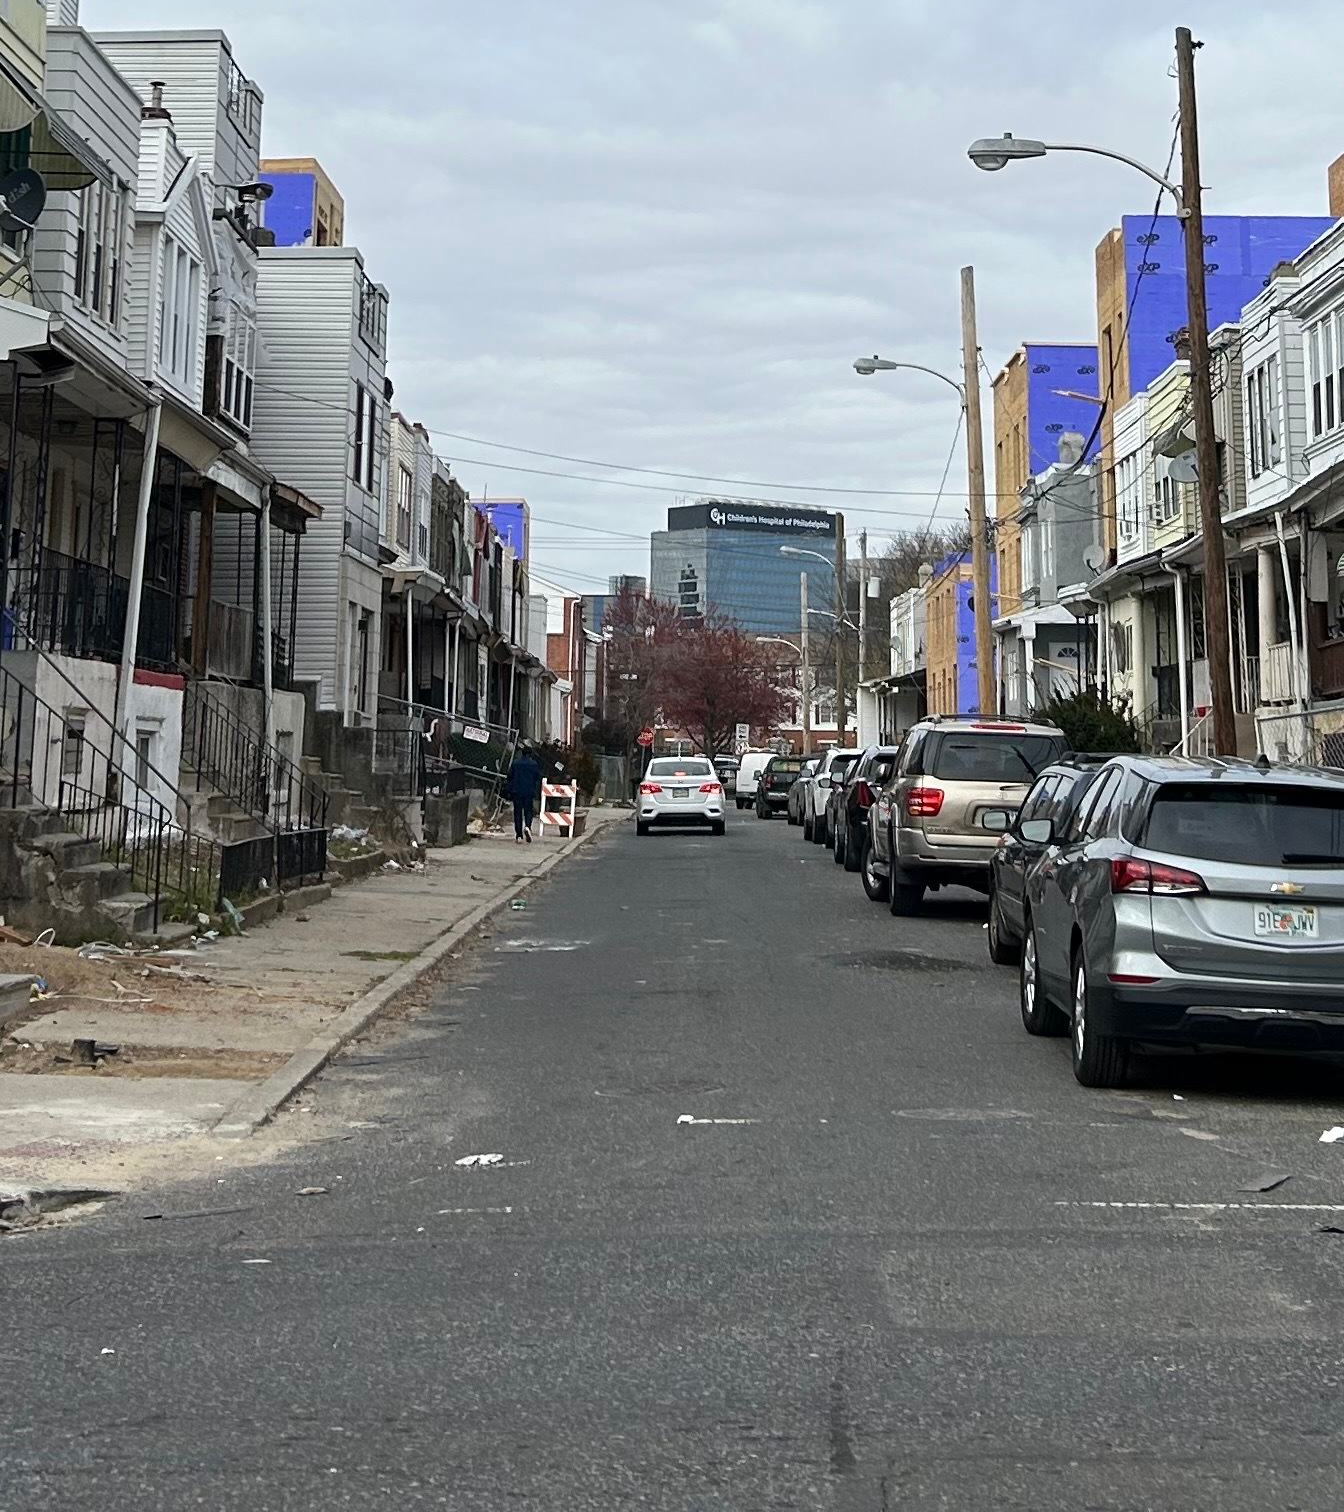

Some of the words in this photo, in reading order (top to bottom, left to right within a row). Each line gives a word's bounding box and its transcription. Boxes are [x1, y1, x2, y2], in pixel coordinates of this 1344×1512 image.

[727, 513, 758, 524] Children's
[759, 515, 784, 526] Hospital
[785, 518, 792, 526] of
[793, 518, 830, 530] Philadelphia
